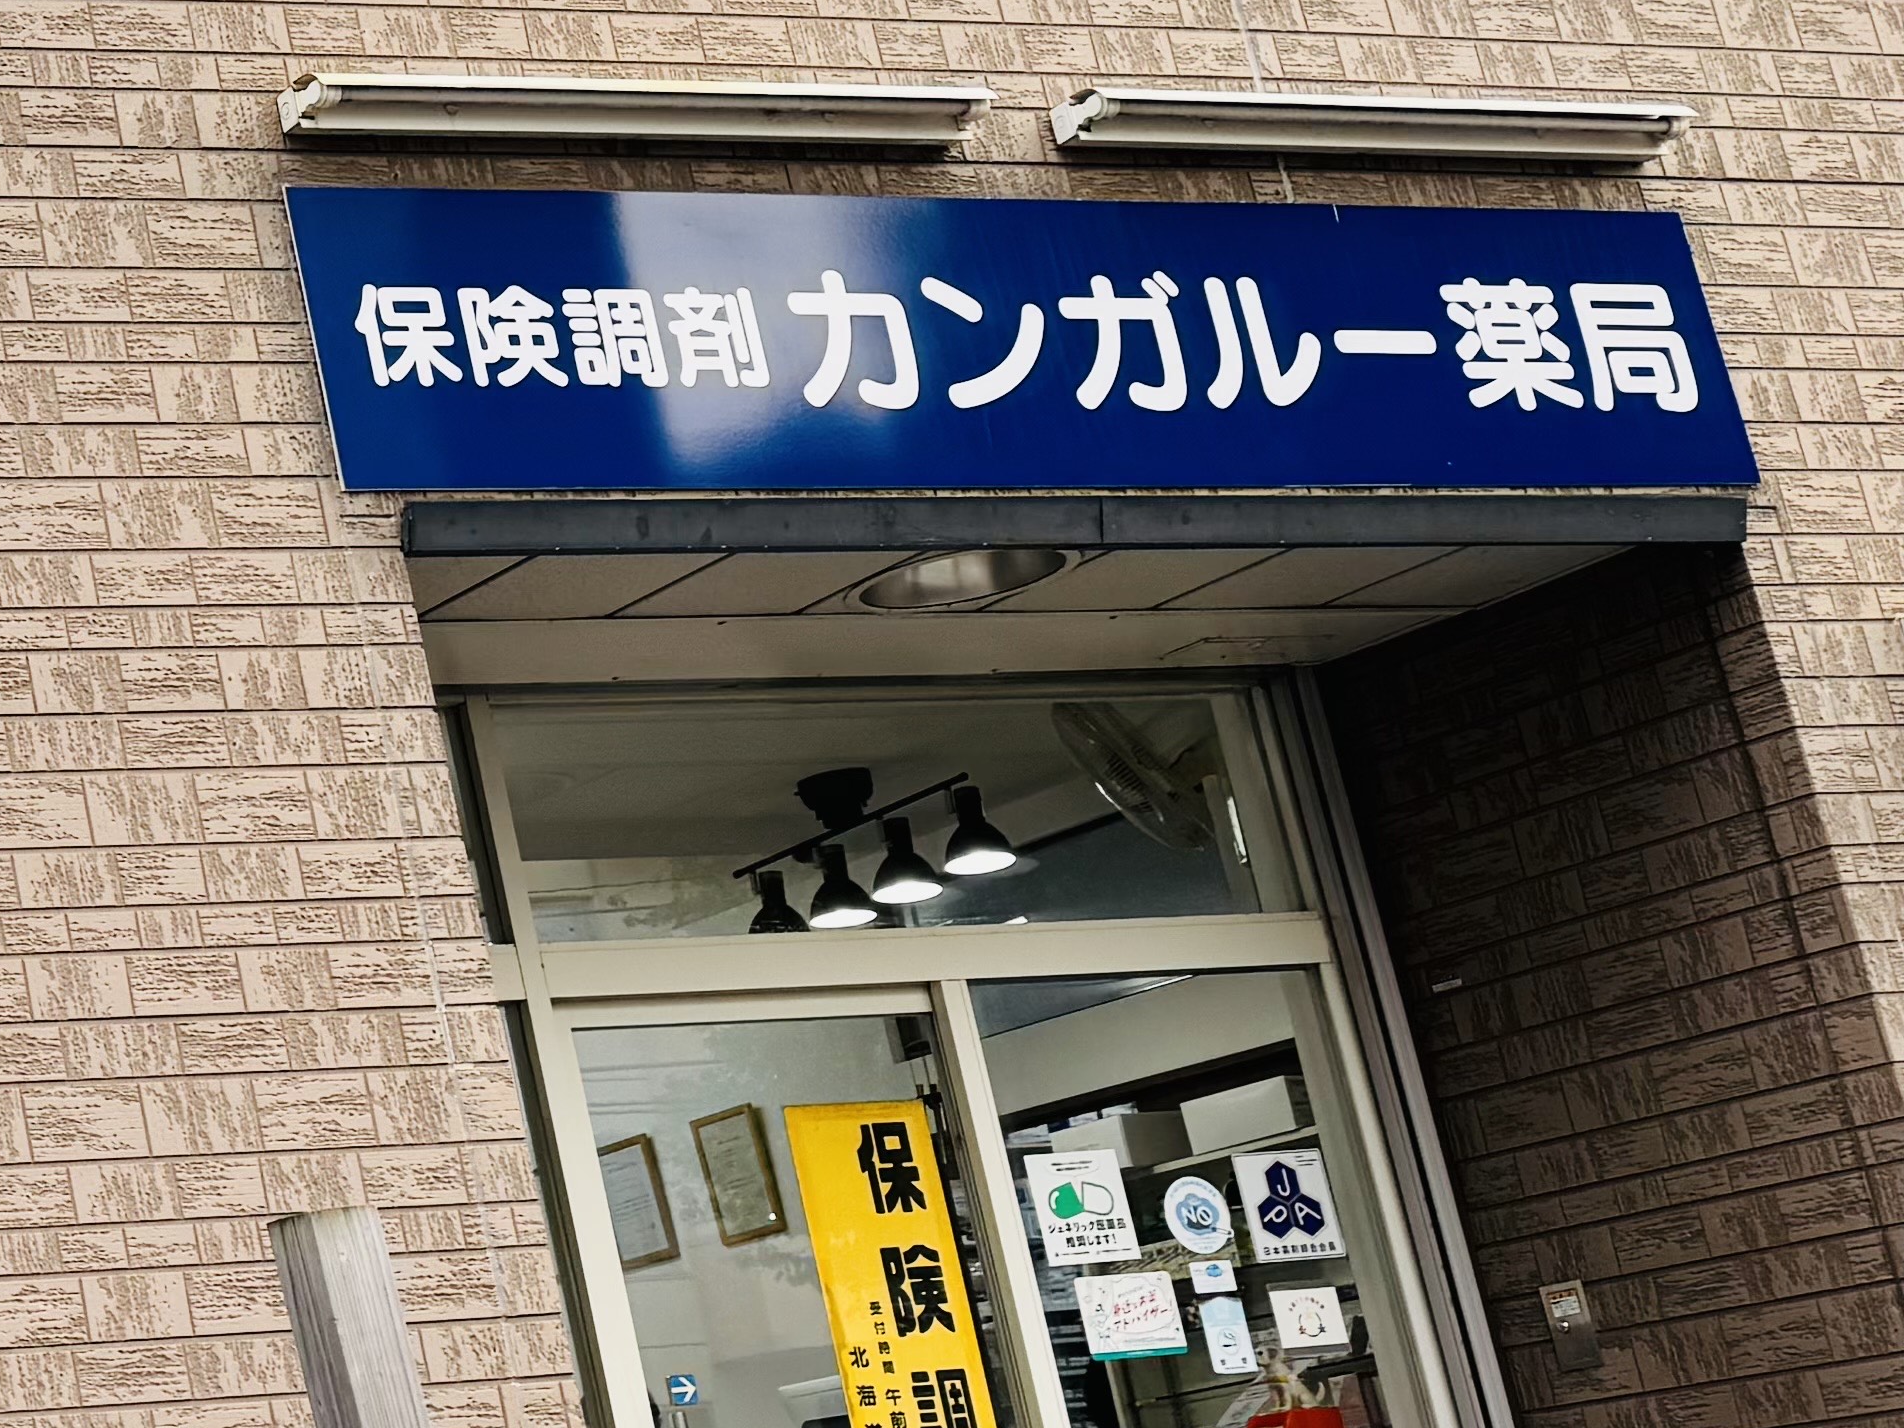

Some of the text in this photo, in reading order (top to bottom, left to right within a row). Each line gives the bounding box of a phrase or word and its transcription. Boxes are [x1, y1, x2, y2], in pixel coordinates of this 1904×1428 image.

[354, 269, 1699, 413] 保険調剤 カンガルー薬局
